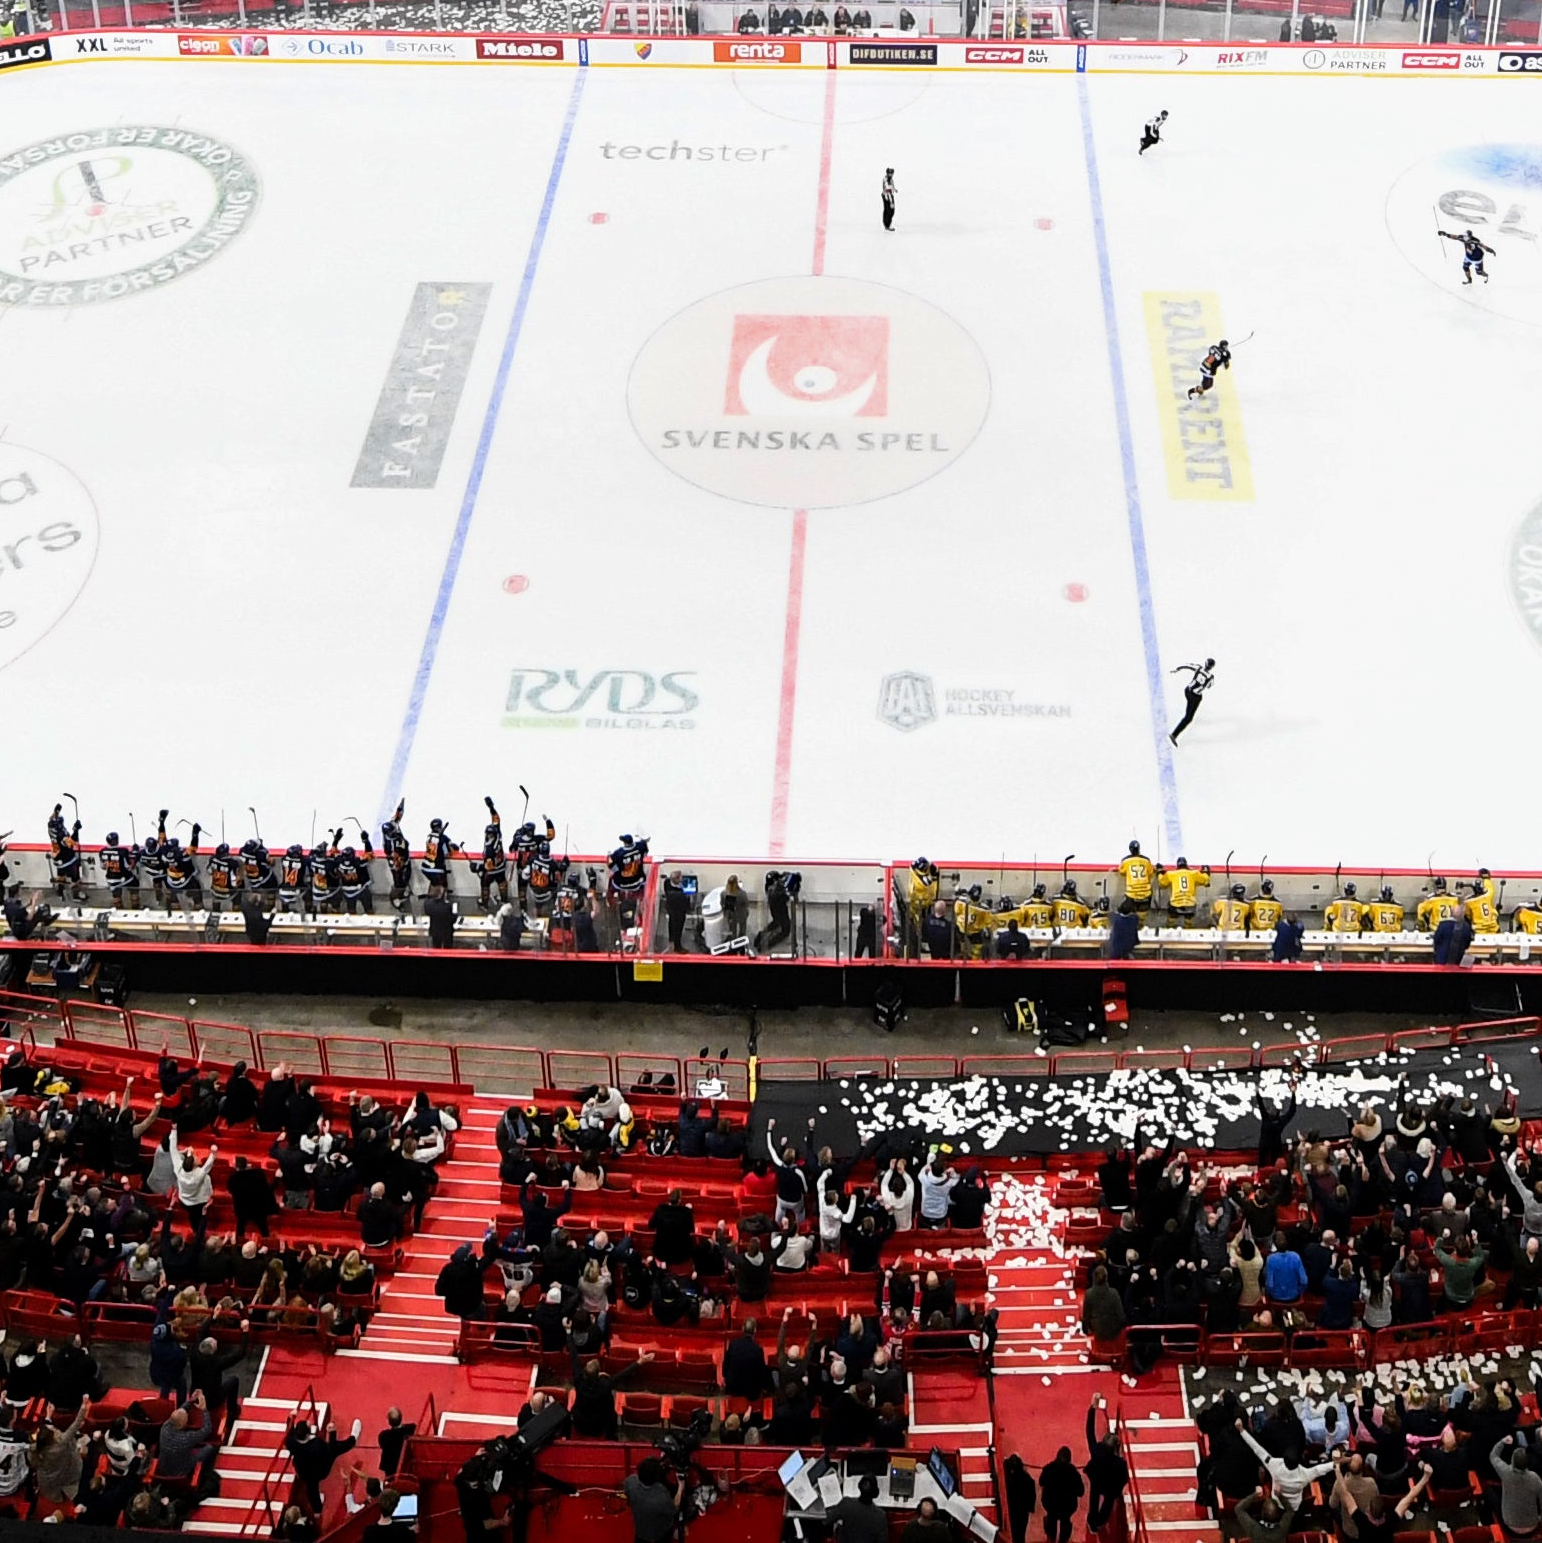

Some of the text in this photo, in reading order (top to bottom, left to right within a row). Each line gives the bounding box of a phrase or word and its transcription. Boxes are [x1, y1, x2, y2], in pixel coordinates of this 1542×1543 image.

[76, 38, 108, 53] XXL
[307, 40, 363, 55] Ocab
[396, 43, 455, 54] STARK
[482, 42, 558, 57] Miele
[729, 43, 785, 59] renta
[852, 49, 934, 61] DIFBUTIKEN.SE
[967, 51, 1022, 61] CCM
[1403, 55, 1458, 67] CCM
[1330, 61, 1387, 70] PARTNER
[118, 127, 156, 143] ER
[600, 140, 779, 162] techster
[19, 215, 193, 274] PARTNER
[28, 285, 74, 304] ER
[661, 429, 949, 453] SVENSKA SPEL
[505, 669, 699, 714] RYDS
[945, 689, 1014, 703] HOCKEY
[945, 704, 1072, 718] ALLSVENSKAN
[585, 718, 697, 730] BILGLAS
[1130, 864, 1146, 878] 52
[1180, 875, 1189, 889] 8
[1060, 909, 1076, 923] 80
[1481, 903, 1490, 916] 6
[1031, 911, 1047, 924] 45
[1380, 911, 1396, 925] 63
